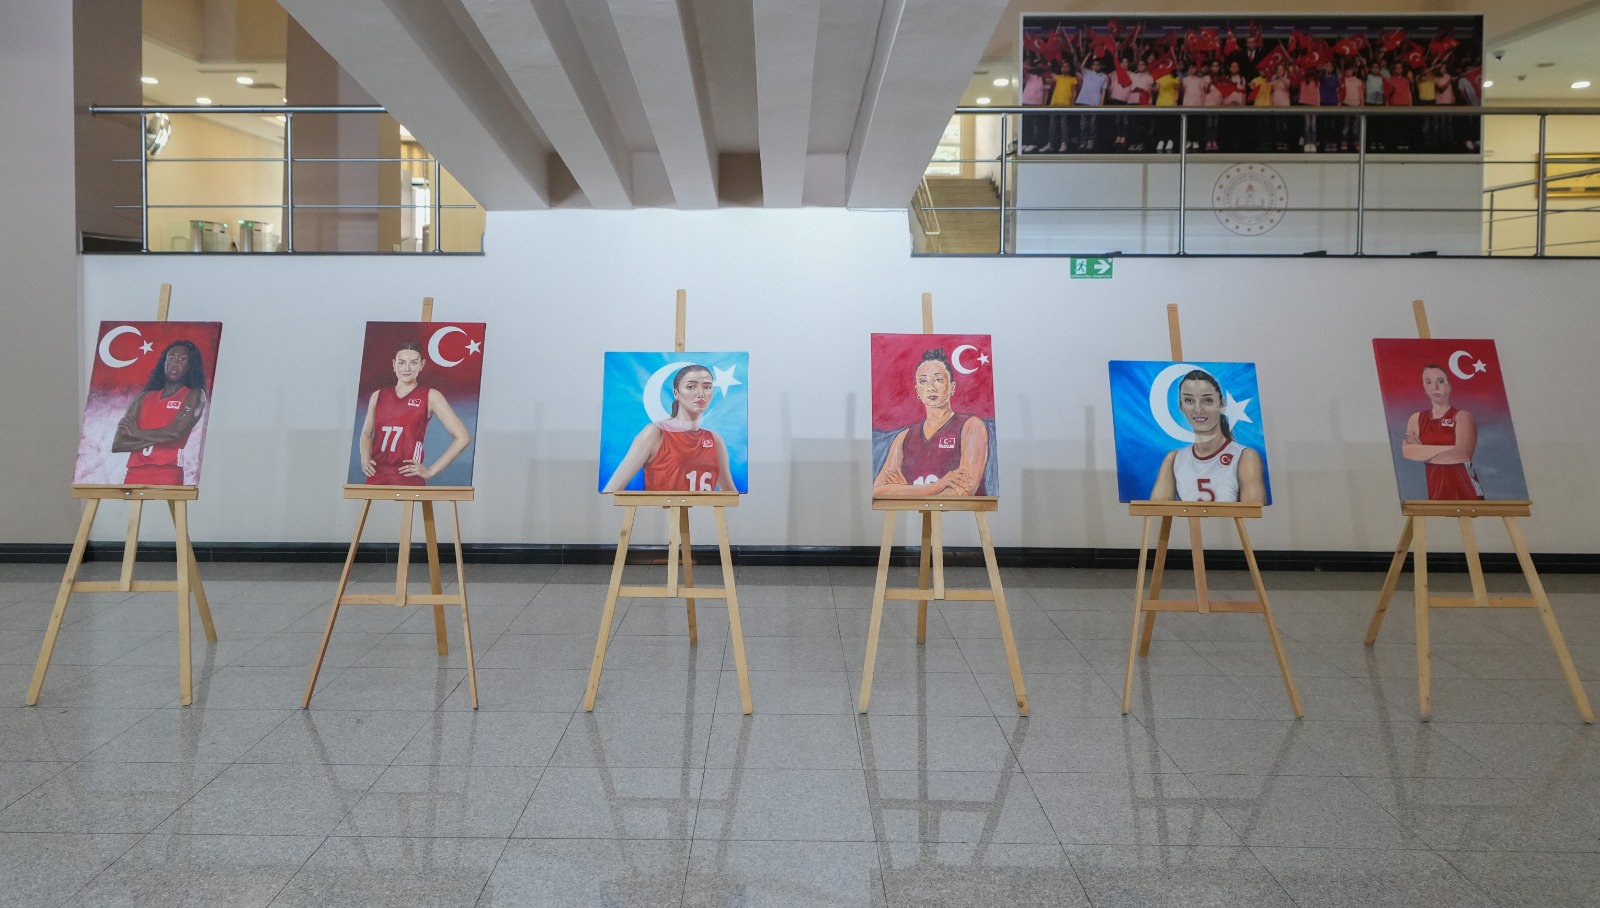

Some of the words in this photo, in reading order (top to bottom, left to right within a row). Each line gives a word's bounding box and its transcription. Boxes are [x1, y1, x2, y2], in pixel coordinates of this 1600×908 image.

[380, 426, 404, 453] 77
[685, 470, 713, 492] 16
[1197, 478, 1216, 502] 5
